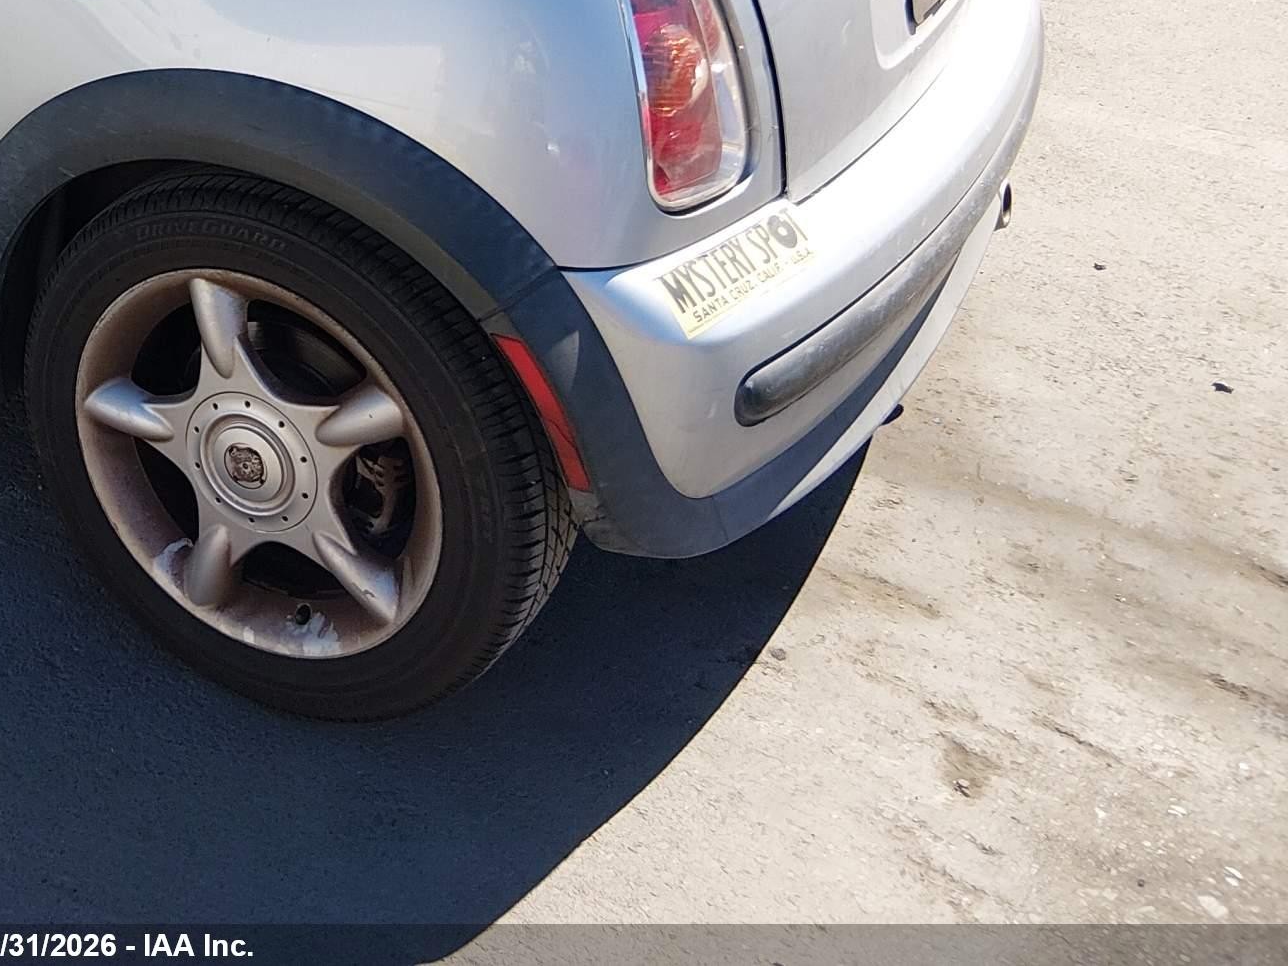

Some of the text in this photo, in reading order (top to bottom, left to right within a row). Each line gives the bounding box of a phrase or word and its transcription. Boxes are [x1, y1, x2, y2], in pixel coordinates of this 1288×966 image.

[657, 207, 809, 313] MYSTERY SPOT
[692, 295, 730, 323] SANTA
